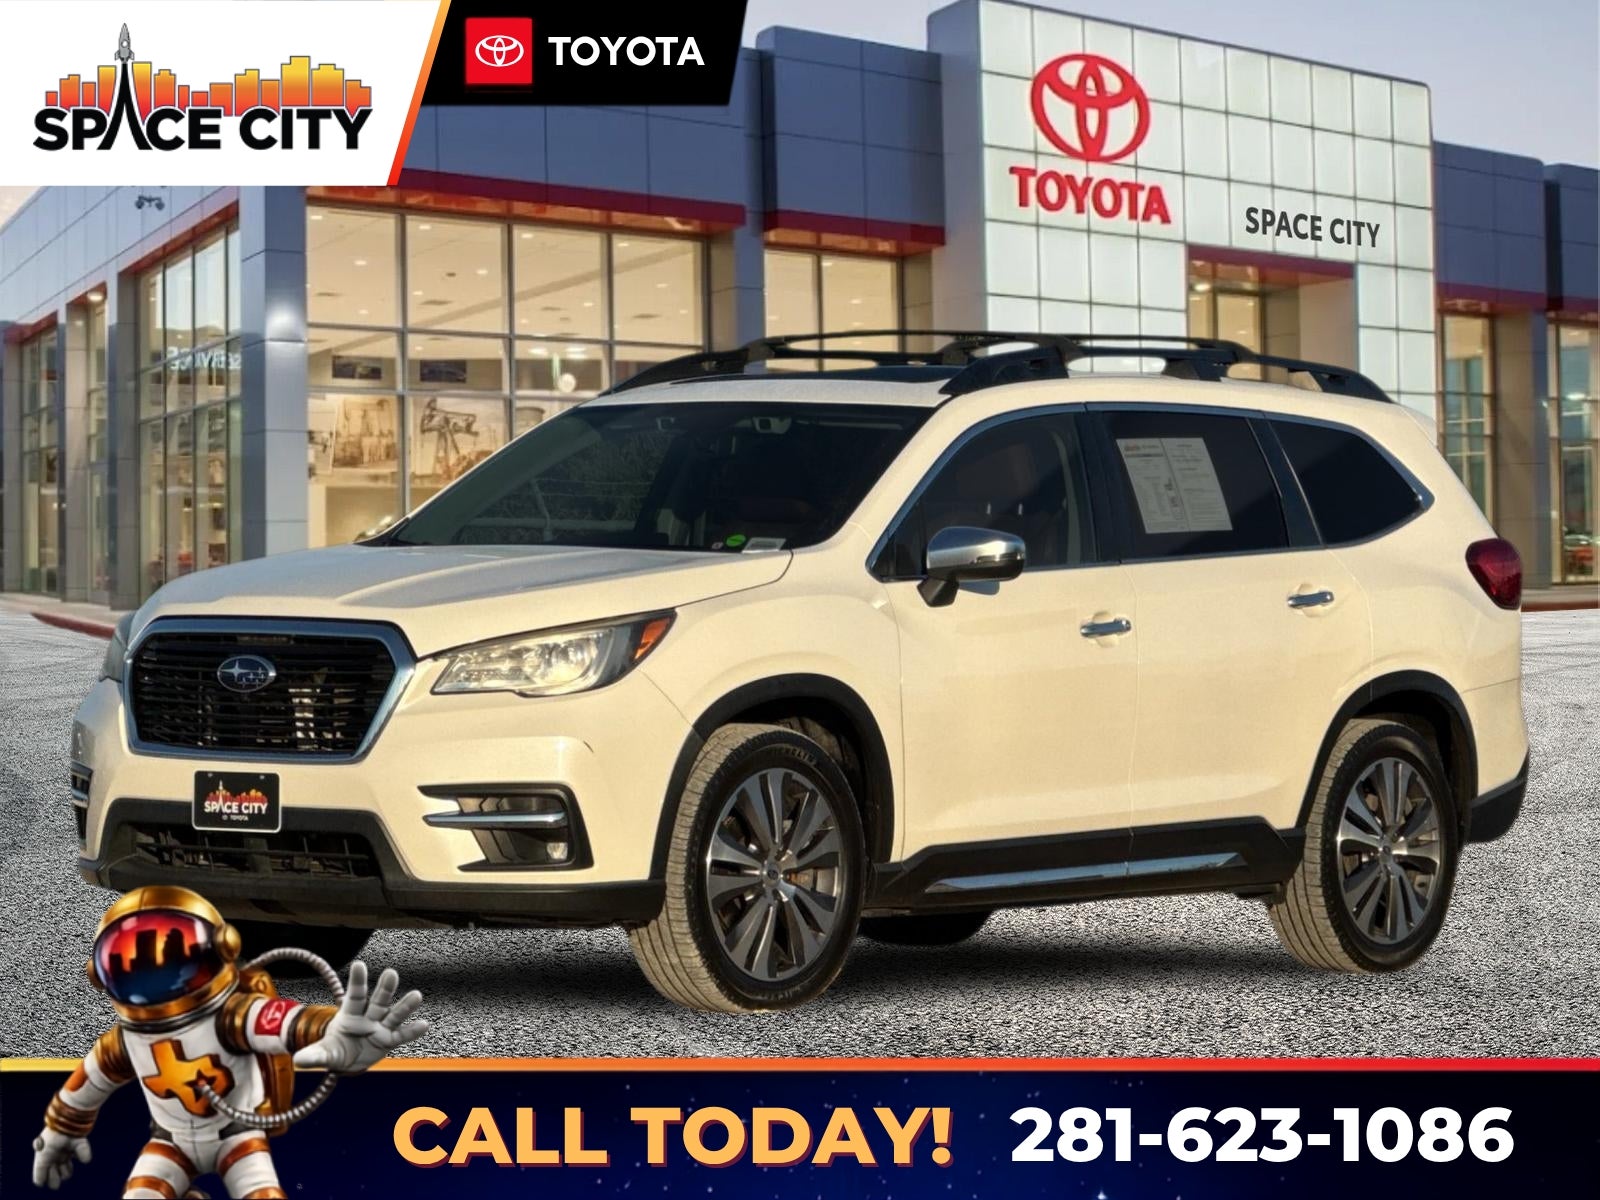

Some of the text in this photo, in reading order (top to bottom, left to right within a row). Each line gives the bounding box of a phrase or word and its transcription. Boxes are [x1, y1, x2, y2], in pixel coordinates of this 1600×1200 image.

[1008, 165, 1172, 225] TOYOTA
[1244, 206, 1381, 248] SPACE CITY
[204, 800, 268, 815] SPACE CITY
